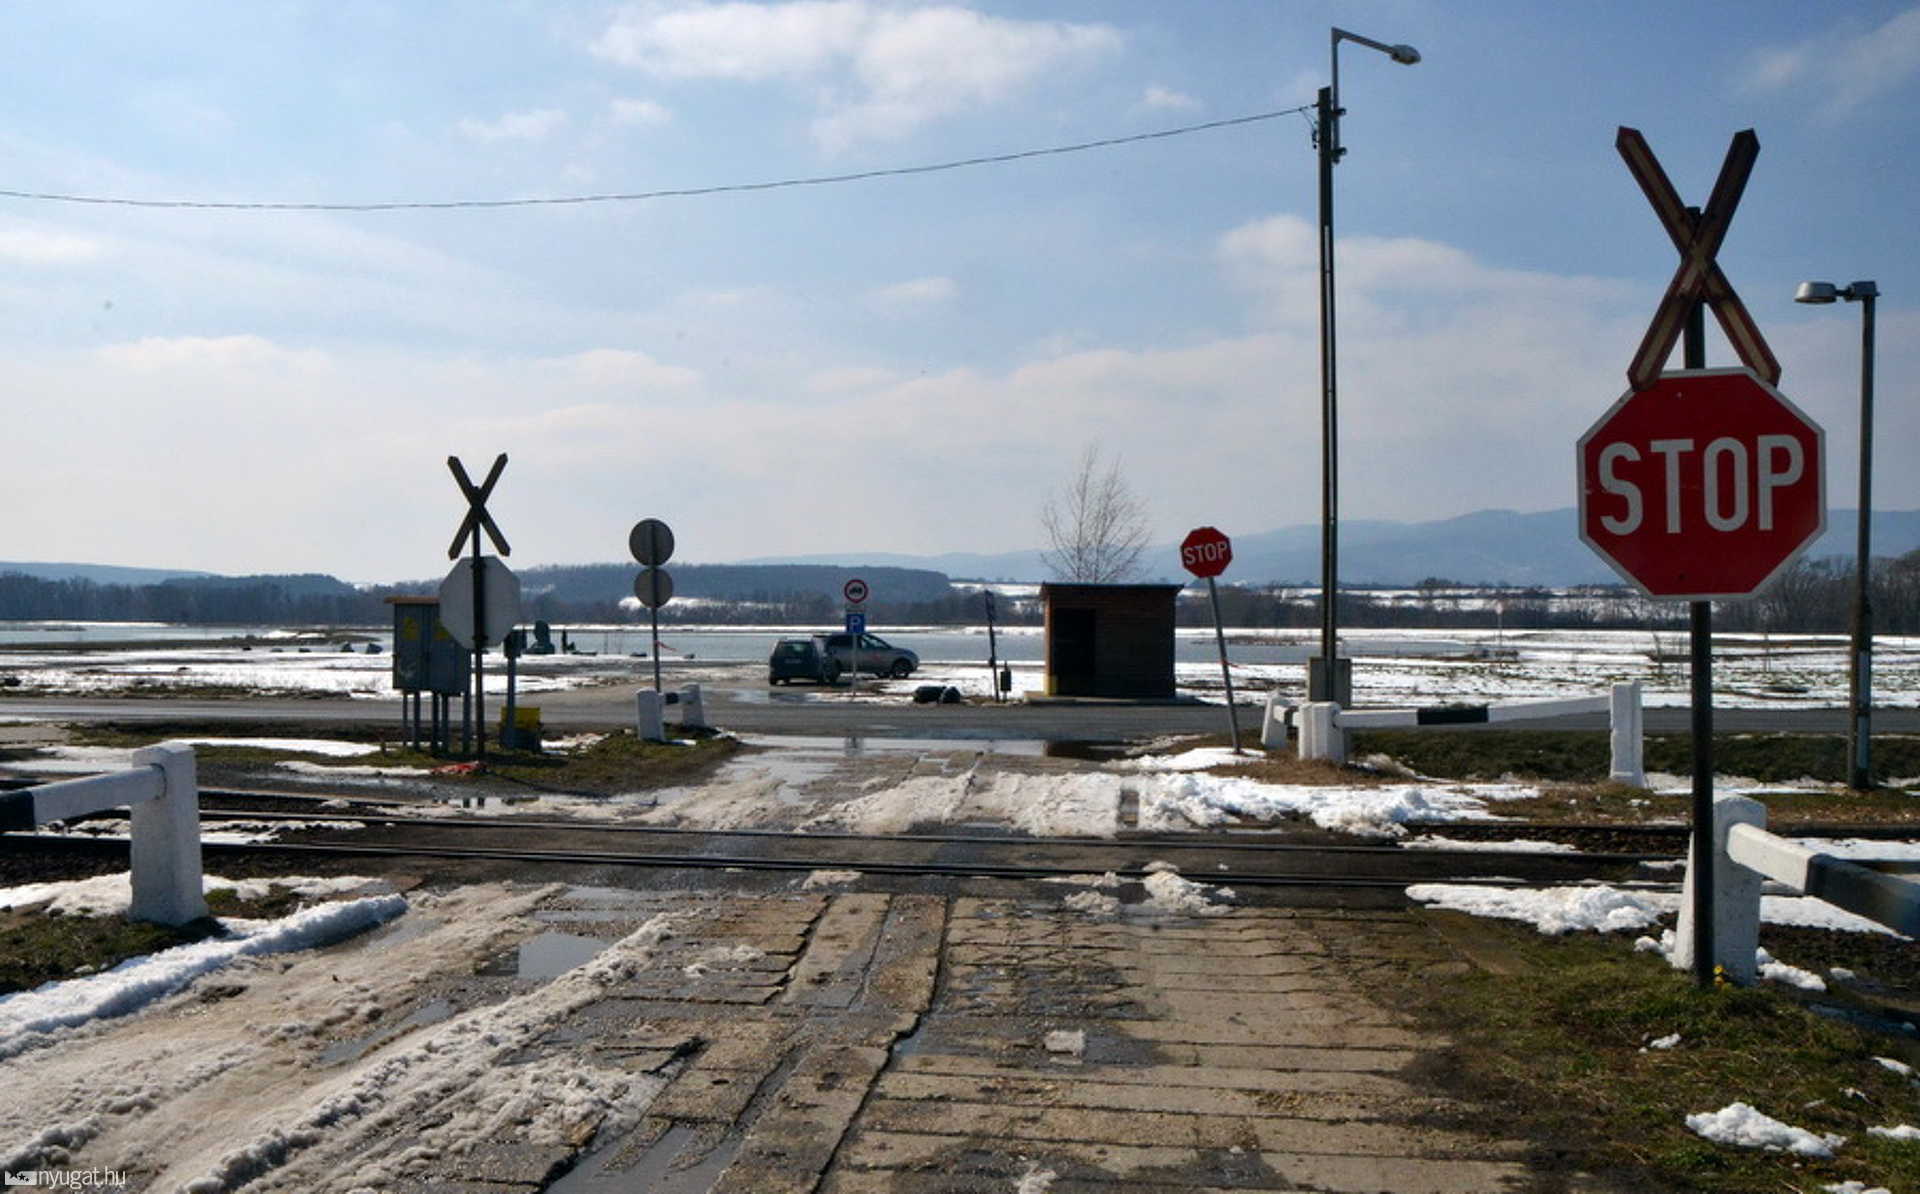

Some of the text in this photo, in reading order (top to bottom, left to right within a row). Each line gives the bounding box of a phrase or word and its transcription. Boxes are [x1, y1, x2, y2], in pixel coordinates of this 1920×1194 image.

[1598, 434, 1804, 535] STOP
[1184, 541, 1227, 565] STOP
[850, 616, 861, 632] P
